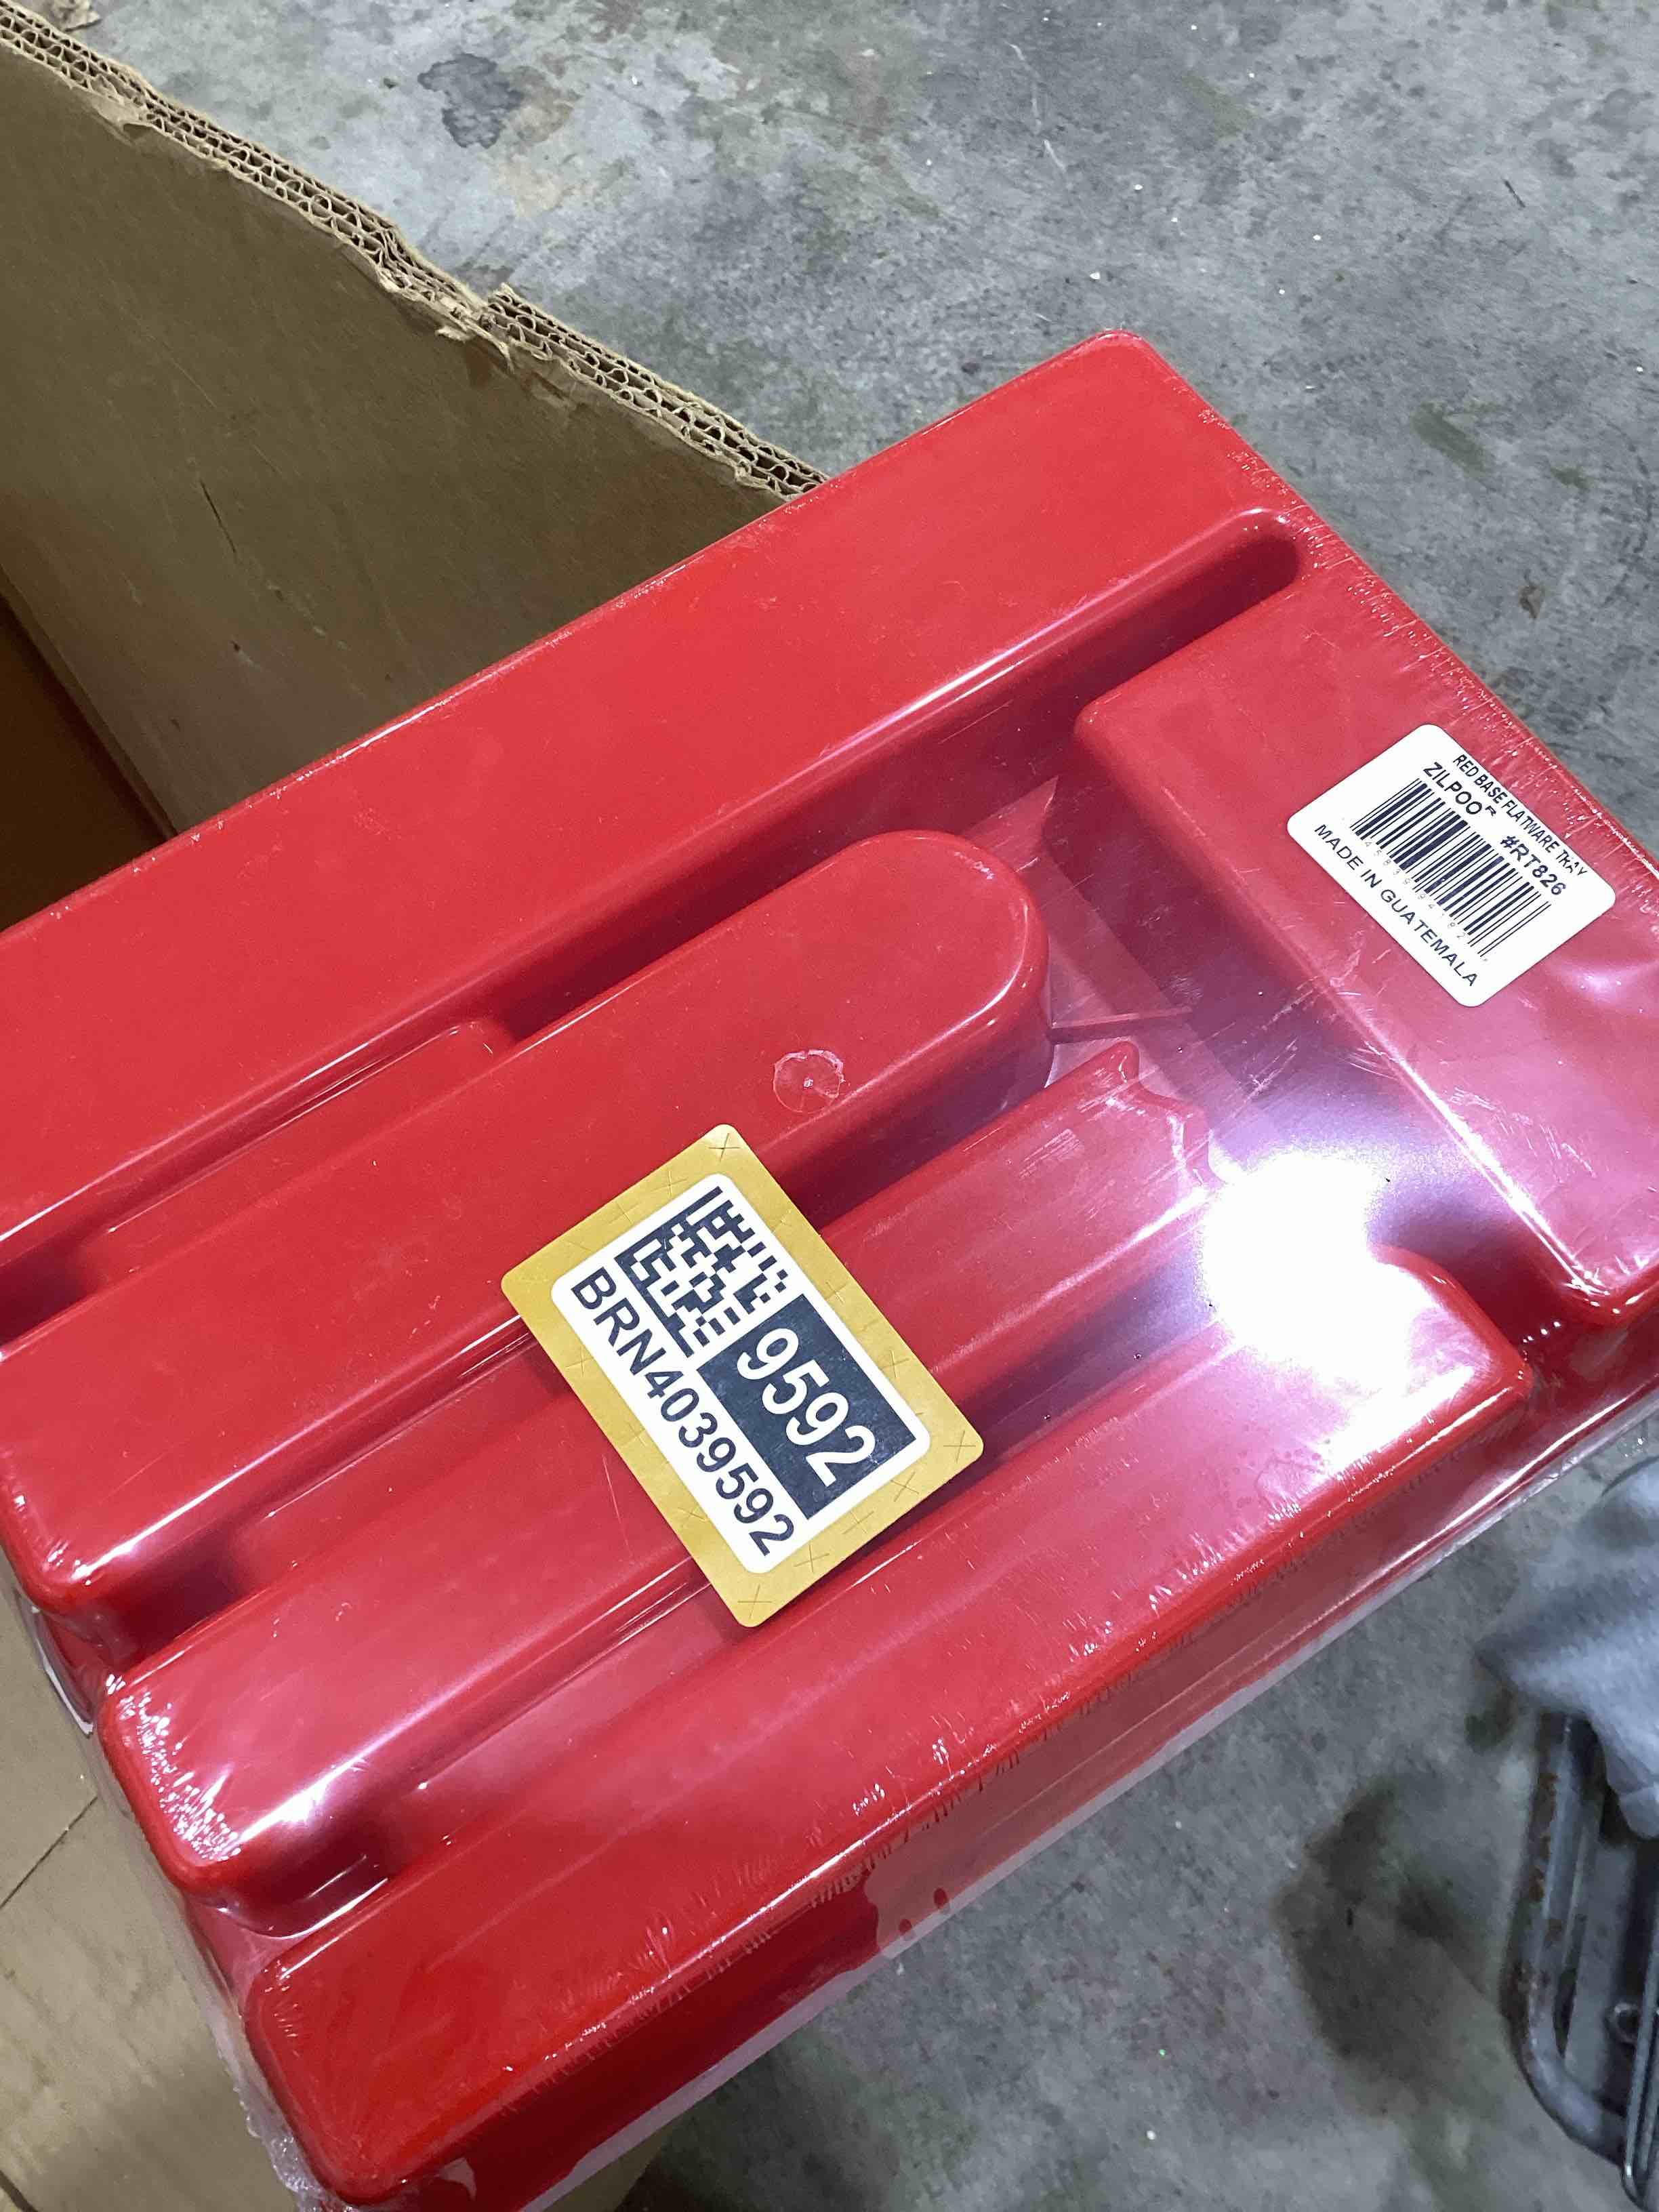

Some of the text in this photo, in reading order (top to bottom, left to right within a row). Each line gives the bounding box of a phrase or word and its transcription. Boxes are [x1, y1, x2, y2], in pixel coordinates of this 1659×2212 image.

[1452, 754, 1479, 777] RED
[1474, 775, 1508, 804] BASE
[1501, 799, 1560, 853] FLATWARE
[1500, 835, 1567, 895] #RT826
[1314, 824, 1478, 987] MADE IN GUATEMALA
[570, 1267, 795, 1557] BRN4039592
[736, 1328, 876, 1487] 9592
